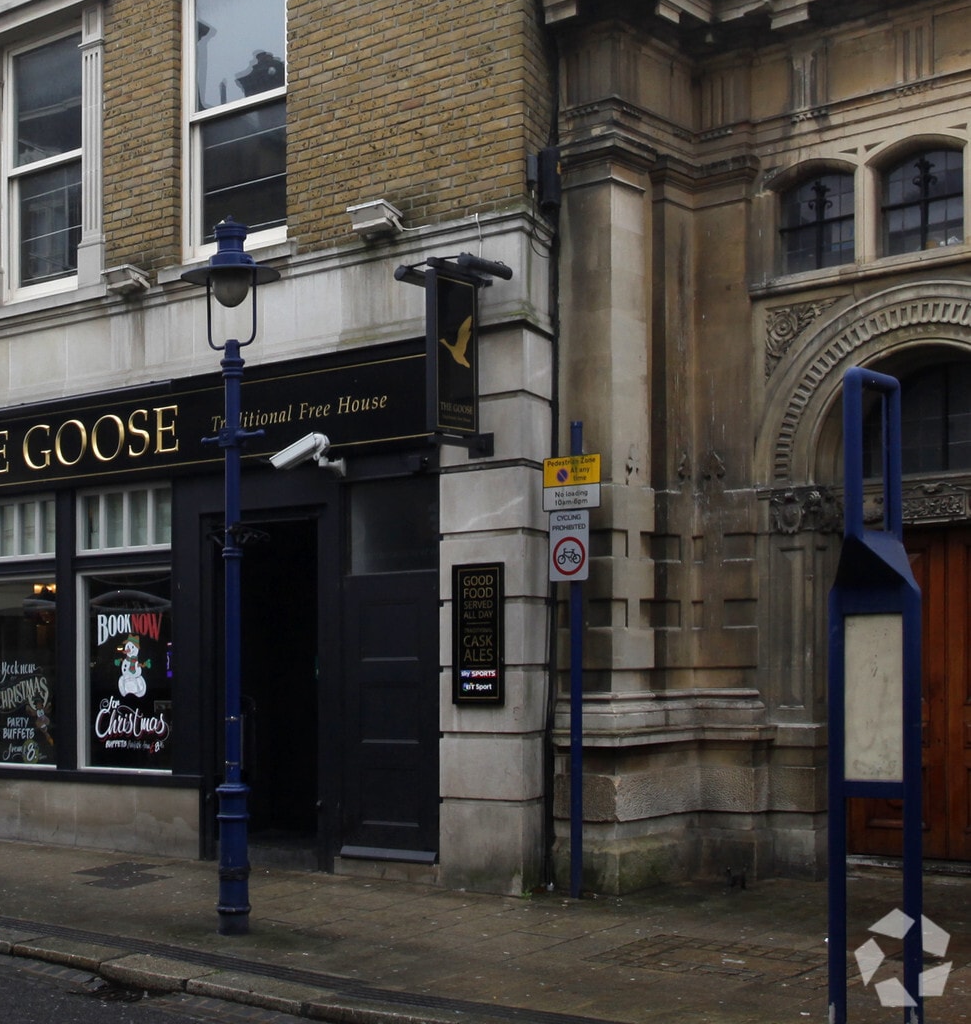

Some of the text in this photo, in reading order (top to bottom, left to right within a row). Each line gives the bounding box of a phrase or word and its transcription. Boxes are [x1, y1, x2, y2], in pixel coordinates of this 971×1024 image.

[211, 394, 388, 432] Tritional Free House
[22, 405, 179, 470] GOOSE
[552, 523, 586, 531] PROHIBITED
[463, 575, 493, 587] GOOD
[463, 587, 493, 599] FOOD
[464, 600, 493, 610] SERVED
[478, 611, 493, 619] DAY
[463, 635, 493, 647] CASK
[463, 648, 493, 662] ALES
[471, 669, 496, 677] SPORTS
[476, 683, 492, 691] Sport
[7, 717, 29, 728] PARTY
[95, 708, 167, 739] Christmas
[2, 728, 35, 740] BUFFETS
